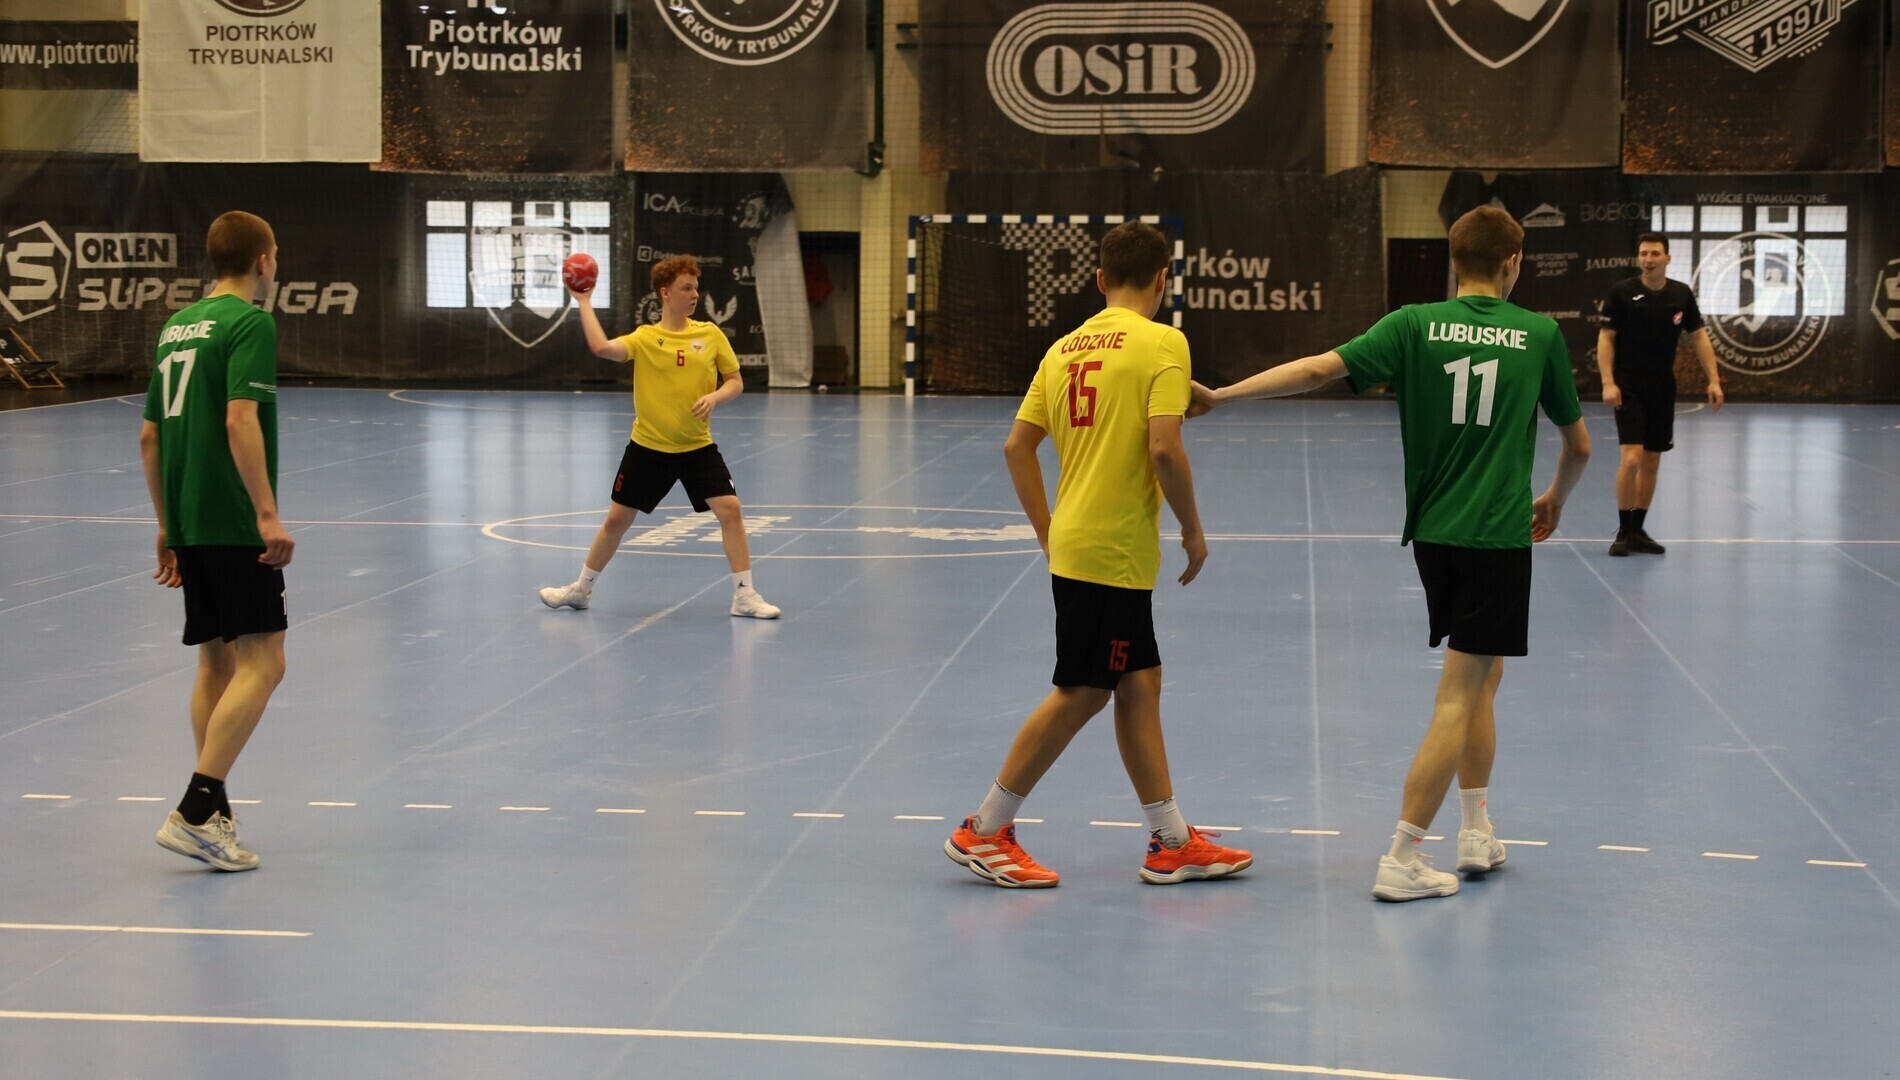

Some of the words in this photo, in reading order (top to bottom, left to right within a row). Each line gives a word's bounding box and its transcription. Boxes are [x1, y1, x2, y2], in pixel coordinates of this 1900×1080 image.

[1653, 0, 1707, 29] PIO
[1760, 0, 1824, 56] 1997
[206, 21, 317, 42] PIOTRKÓW
[428, 19, 563, 45] Piotrków
[188, 46, 334, 65] TRYBUNALSKI
[406, 44, 583, 76] Trybunalski
[1034, 43, 1203, 96] OSiR
[643, 193, 682, 213] ICA
[1696, 192, 1744, 204] WYJŚCIE
[1746, 193, 1829, 204] EWAKUACYJNE
[82, 237, 170, 263] ORLEN
[1061, 332, 1127, 355] ŁÓDZKIE
[1428, 321, 1528, 350] LUBUSKIE
[676, 349, 686, 367] 6
[158, 348, 198, 419] 17
[1066, 360, 1103, 428] 15
[1443, 355, 1499, 427] 11
[1108, 639, 1131, 672] 15
